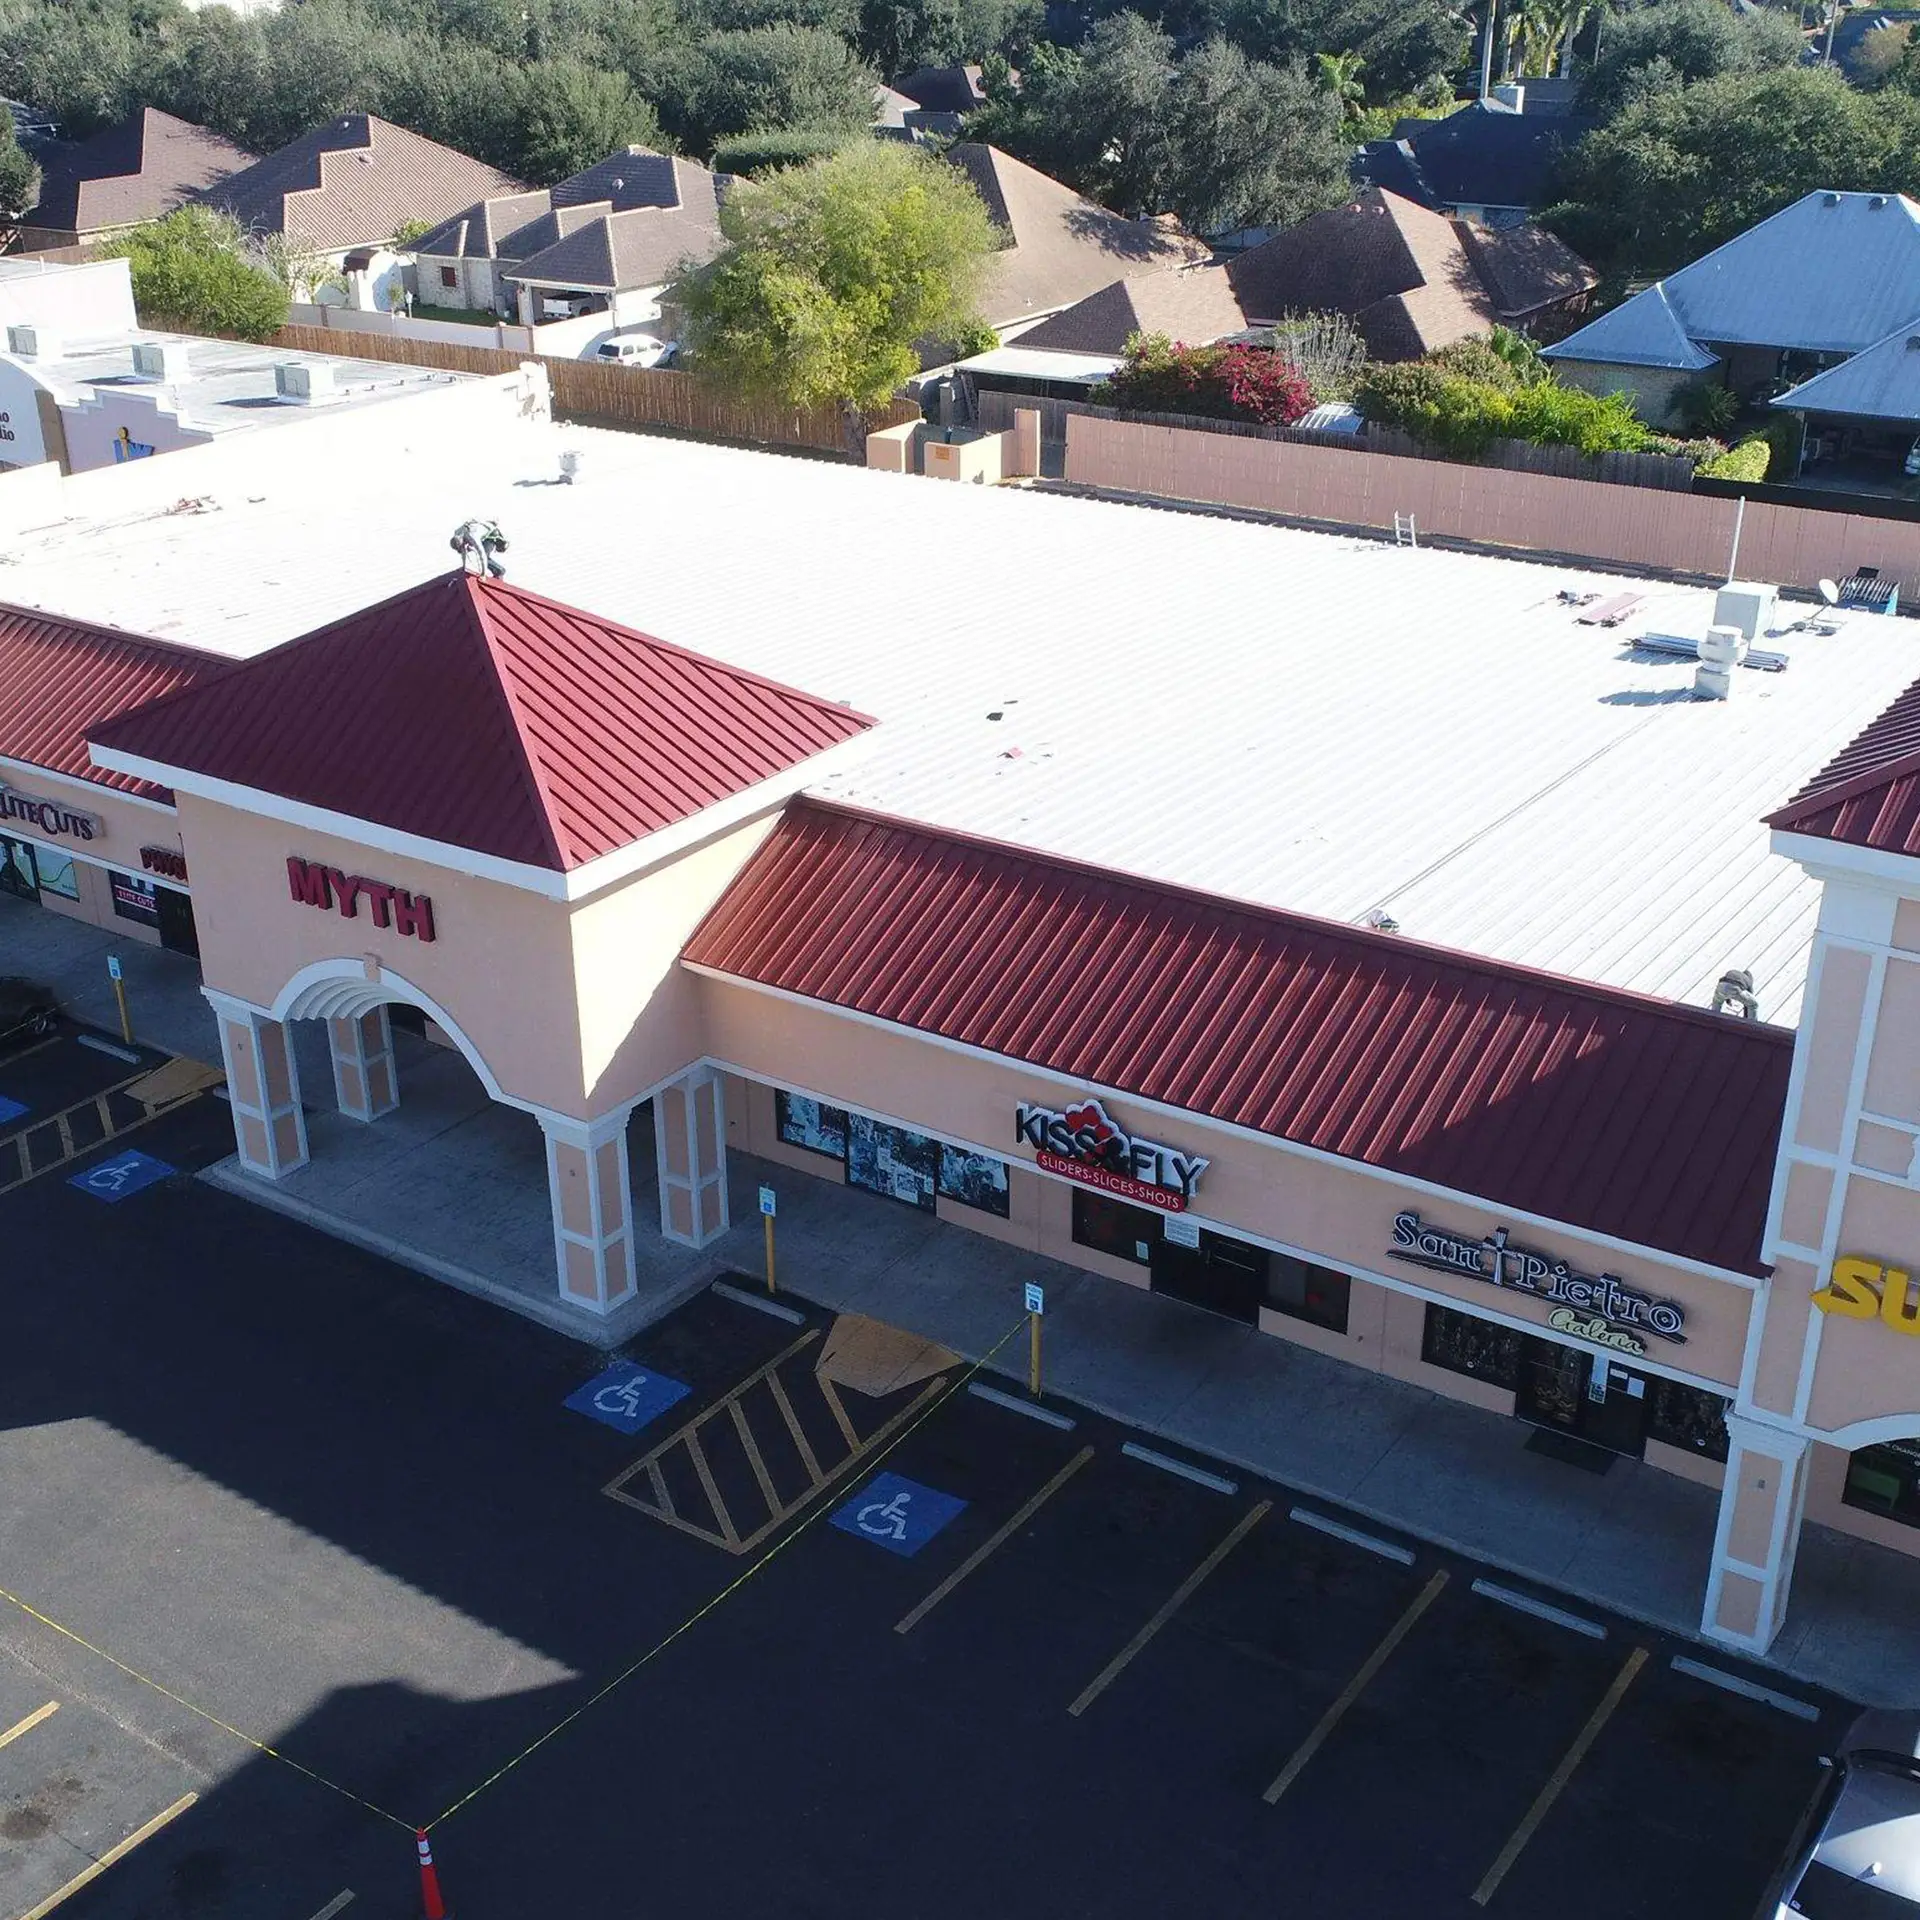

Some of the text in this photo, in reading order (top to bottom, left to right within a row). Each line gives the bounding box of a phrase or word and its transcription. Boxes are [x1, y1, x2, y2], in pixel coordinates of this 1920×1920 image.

[286, 856, 436, 942] MYTH
[1130, 1144, 1203, 1197] FLY
[1391, 1212, 1683, 1334] San Pietro
